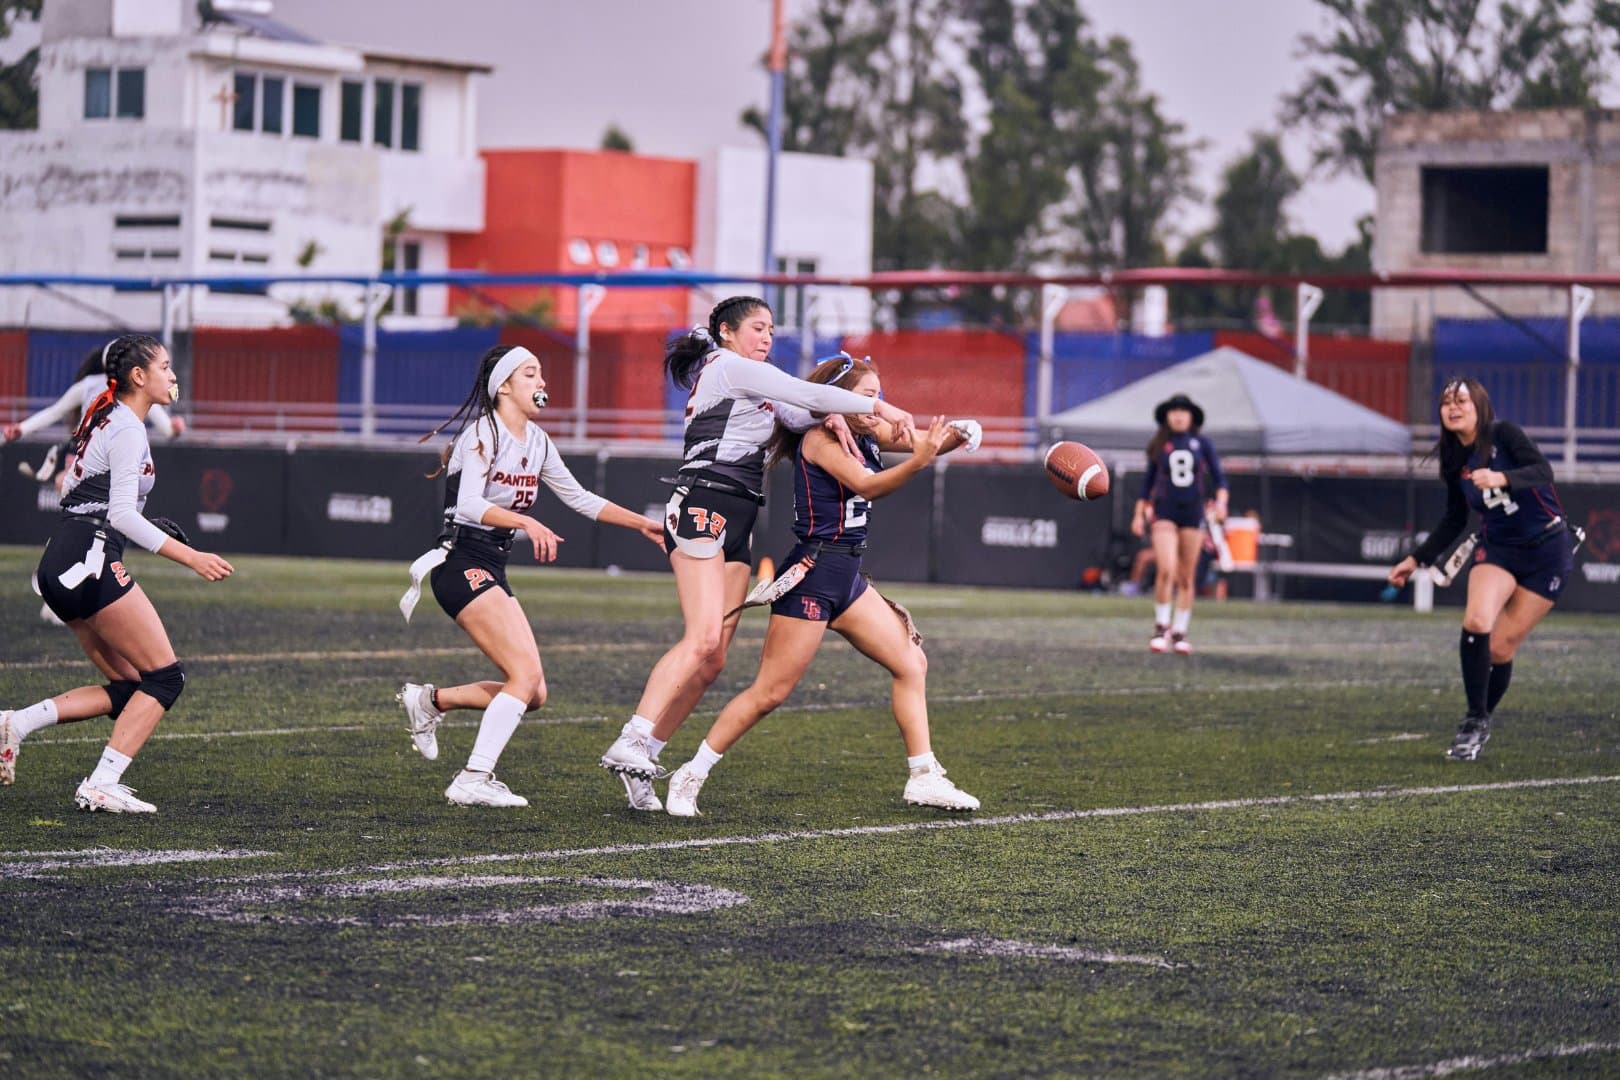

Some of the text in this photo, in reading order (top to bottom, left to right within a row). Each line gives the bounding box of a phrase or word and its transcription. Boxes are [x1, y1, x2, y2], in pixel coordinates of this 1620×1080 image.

[1169, 450, 1195, 488] 8
[510, 490, 534, 510] 25
[687, 506, 727, 538] 72
